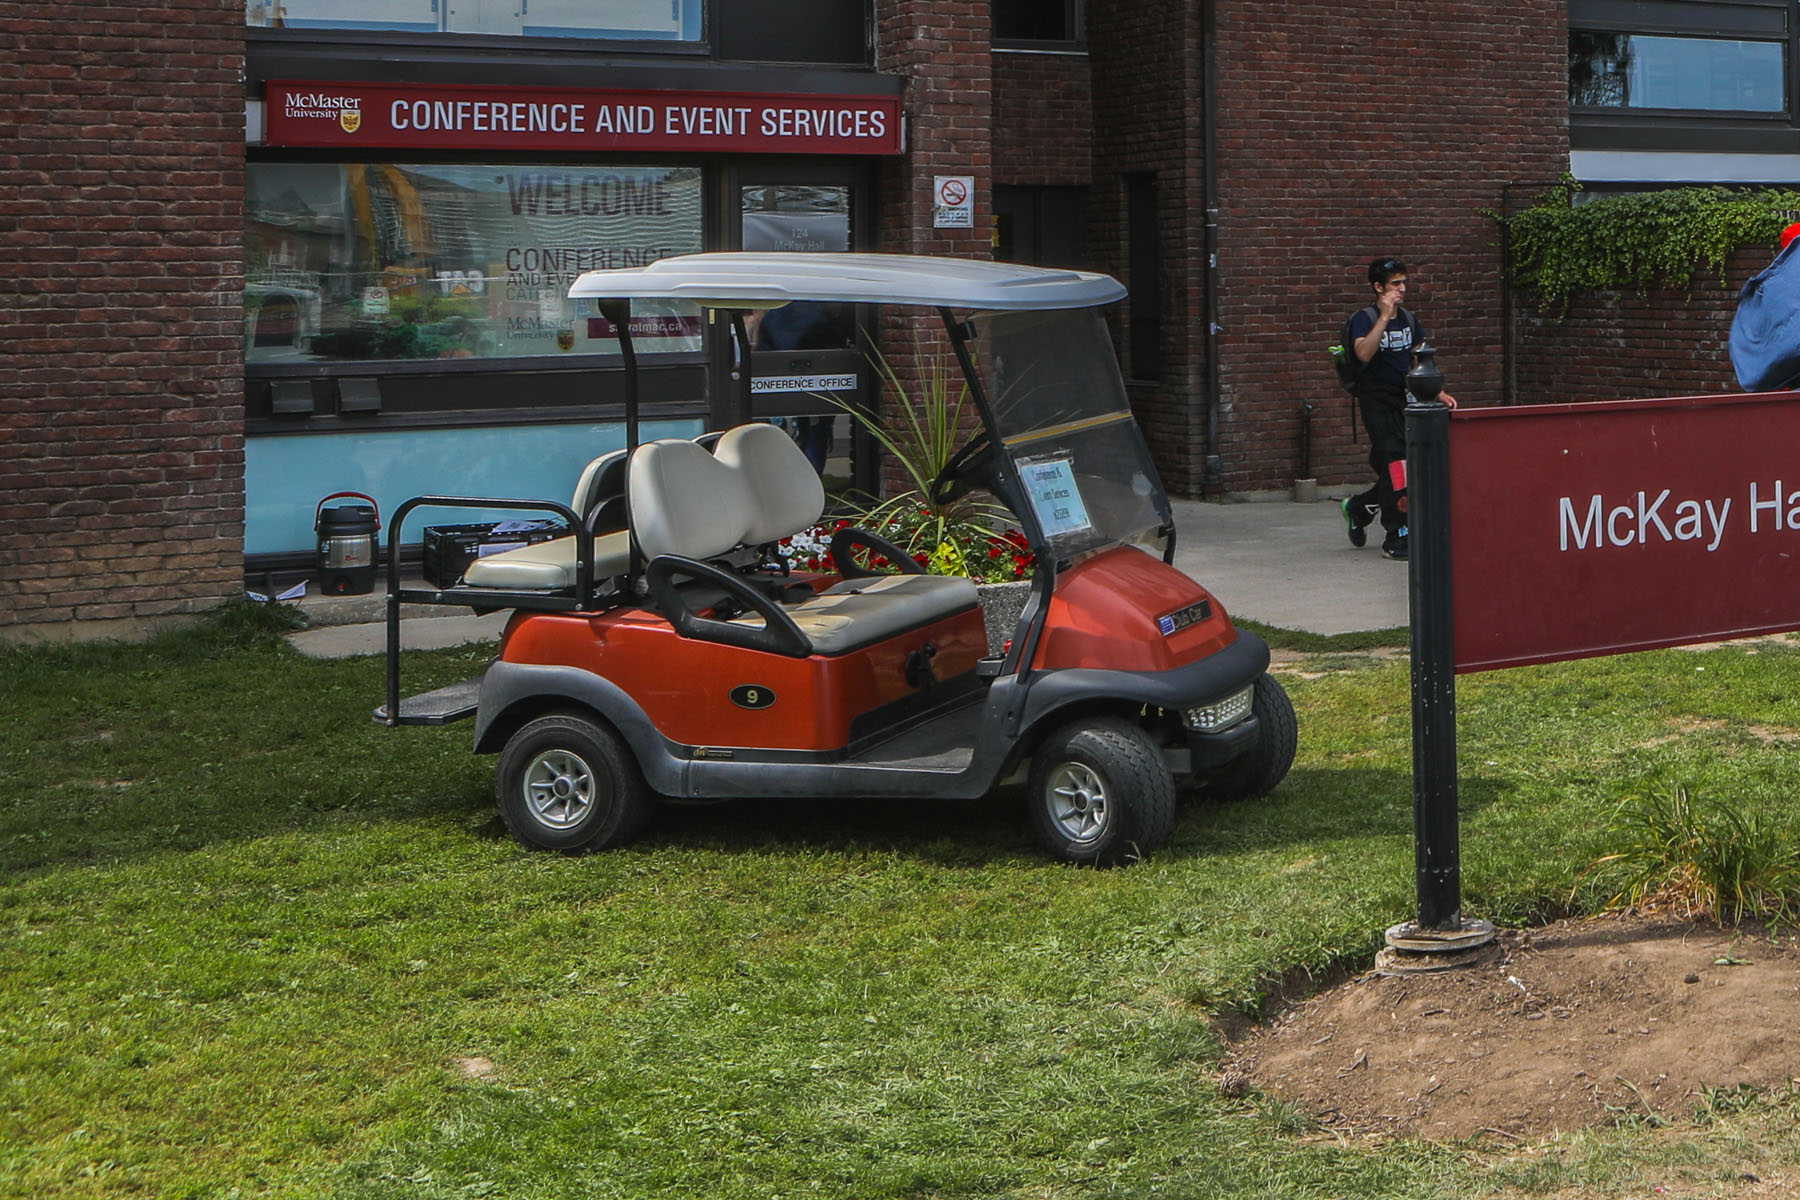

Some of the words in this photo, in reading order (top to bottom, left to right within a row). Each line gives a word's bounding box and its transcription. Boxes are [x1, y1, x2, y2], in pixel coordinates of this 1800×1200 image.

[285, 93, 361, 109] McMaster
[285, 108, 339, 120] University
[390, 99, 585, 133] CONFERENCE
[595, 105, 655, 134] AND
[665, 106, 752, 136] EVENT
[760, 108, 886, 138] SERVICES
[506, 174, 673, 216] WELCOME
[792, 228, 808, 239] 124
[506, 248, 672, 271] CONFERENC
[506, 273, 541, 286] AND
[751, 379, 814, 390] CONFERENCE
[819, 377, 853, 388] OFFICE
[1559, 488, 1732, 551] McKay
[746, 689, 759, 704] 9
